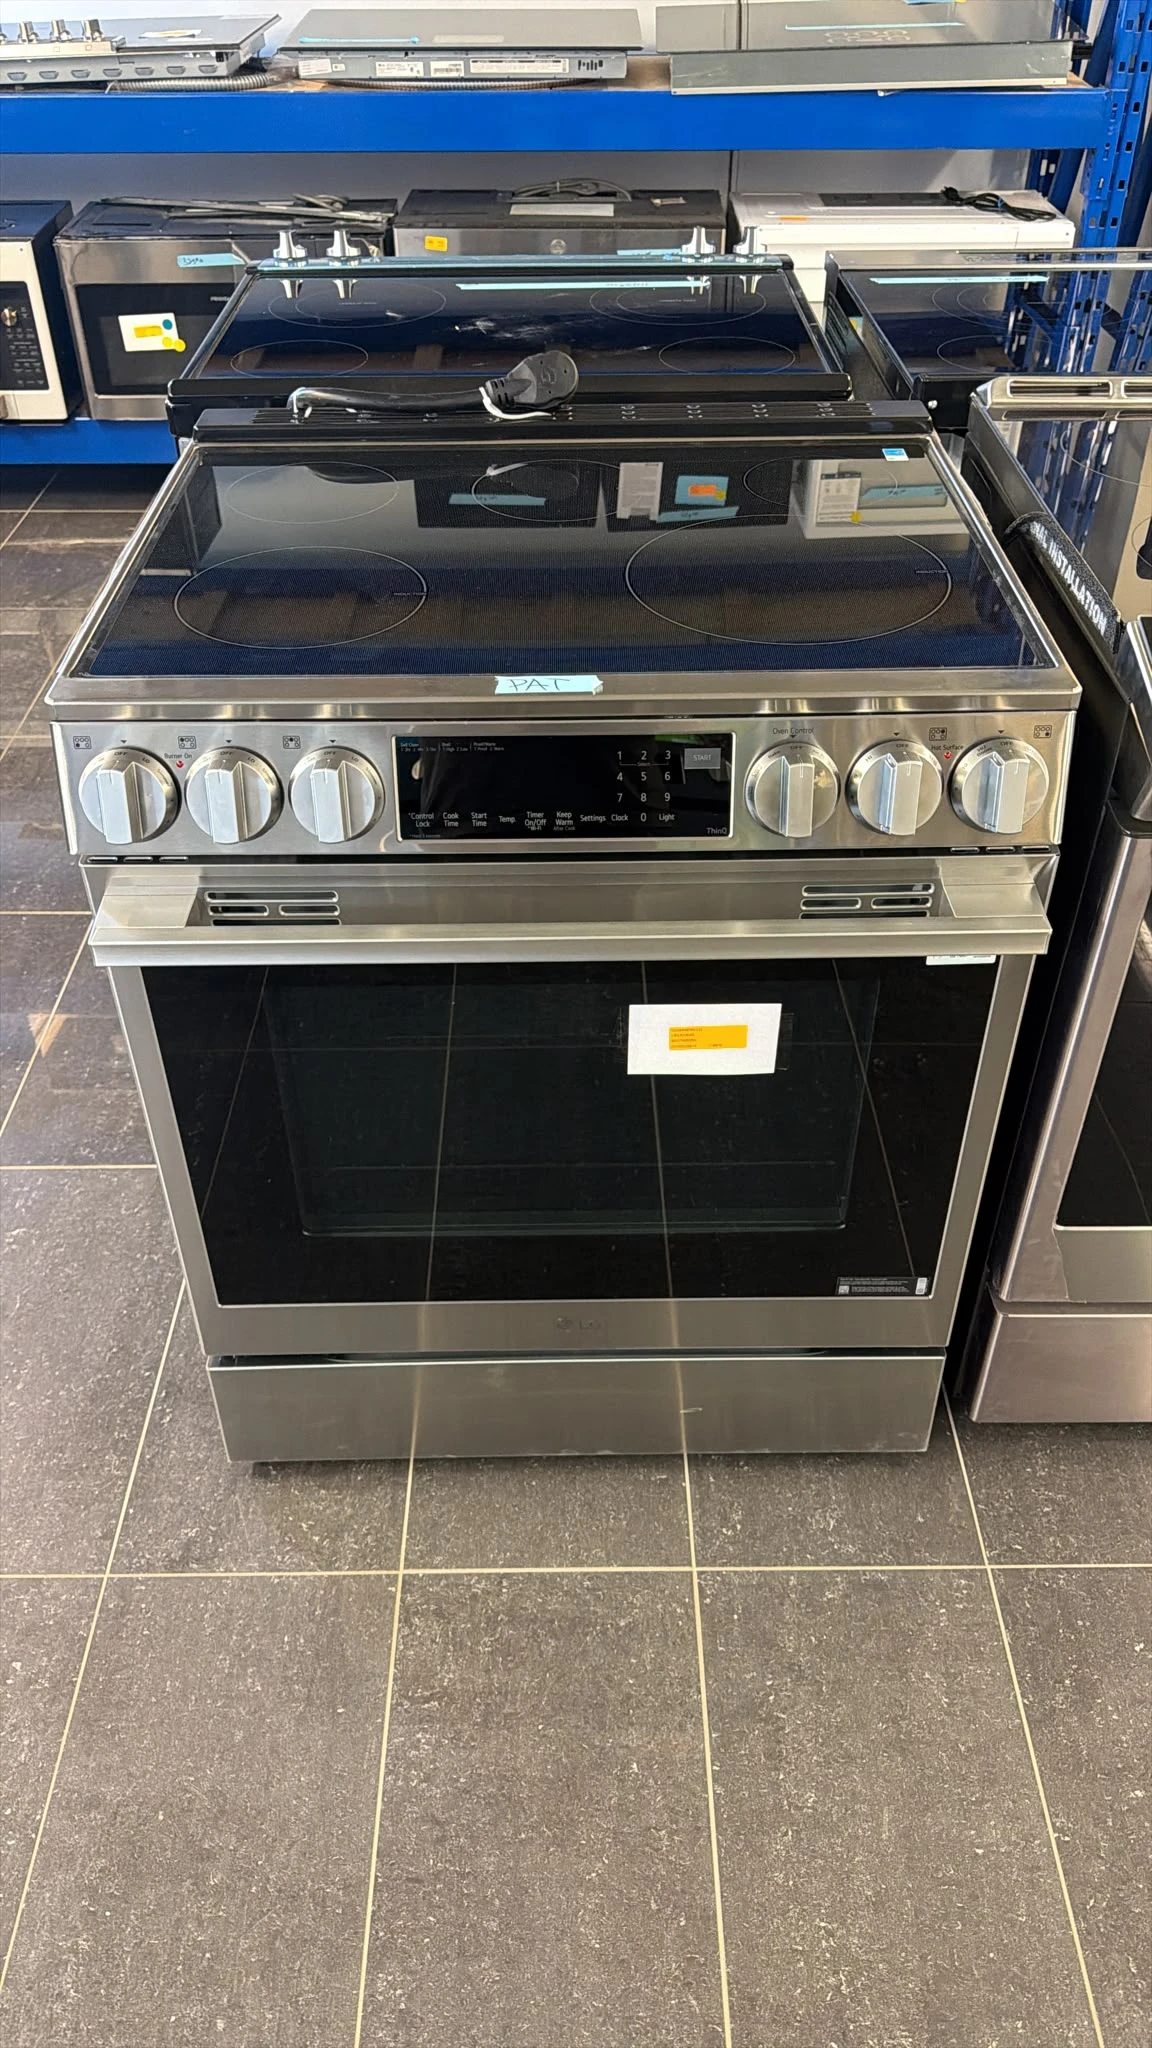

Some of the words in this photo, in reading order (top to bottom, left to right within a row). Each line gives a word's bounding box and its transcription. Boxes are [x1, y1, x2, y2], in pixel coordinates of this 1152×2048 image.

[1048, 539, 1107, 636] INSTALLATION
[507, 678, 570, 692] PAT
[617, 752, 622, 760] 1
[641, 751, 647, 760] 2
[665, 750, 671, 760] 3
[617, 772, 623, 781] 4
[641, 772, 647, 781] 5
[664, 772, 671, 781] 6
[617, 793, 623, 802] 7
[640, 793, 647, 802] 8
[665, 793, 671, 802] 9
[556, 811, 572, 819] Keep
[580, 814, 606, 822] Settings
[640, 812, 646, 821] 0
[659, 813, 675, 822] Light
